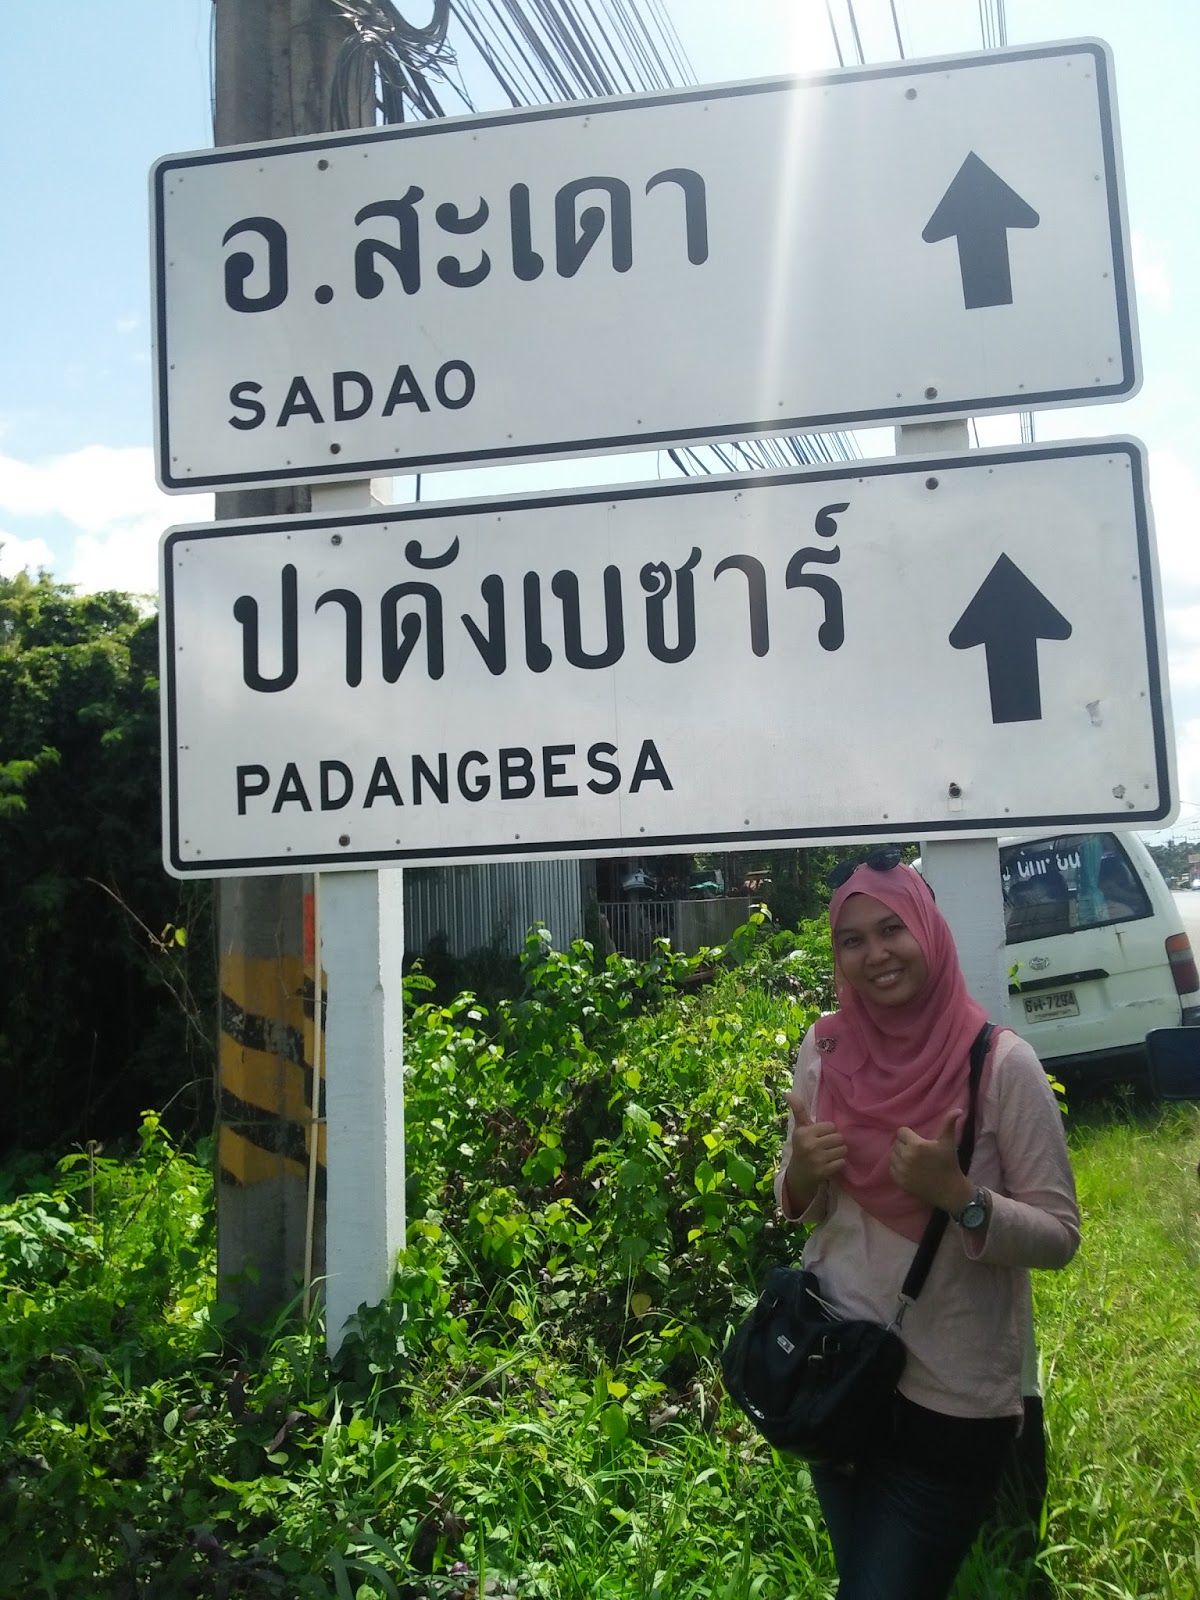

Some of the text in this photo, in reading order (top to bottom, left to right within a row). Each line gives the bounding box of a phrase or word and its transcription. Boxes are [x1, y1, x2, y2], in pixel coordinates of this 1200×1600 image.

[221, 168, 709, 314] อ.สะเดา
[228, 360, 476, 430] SADAO
[232, 502, 851, 693] ปาดังเบซาร์
[236, 738, 674, 816] PADANGBESA
